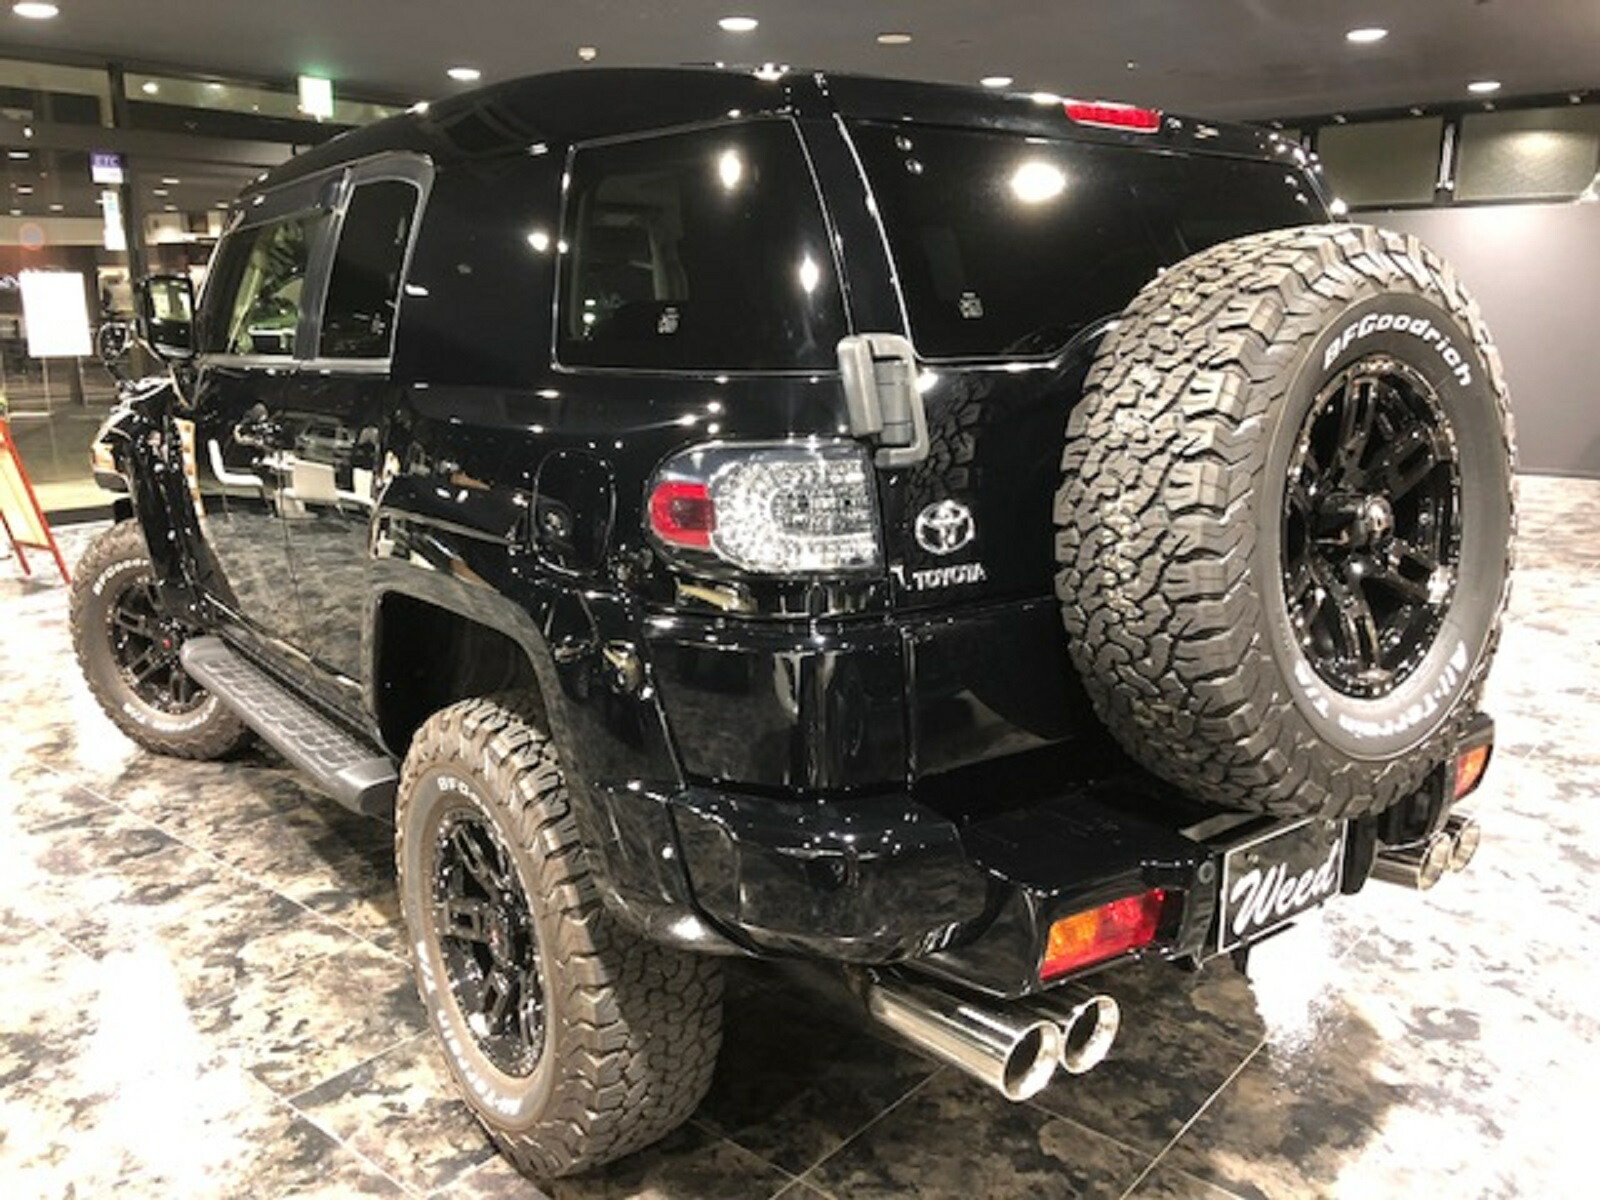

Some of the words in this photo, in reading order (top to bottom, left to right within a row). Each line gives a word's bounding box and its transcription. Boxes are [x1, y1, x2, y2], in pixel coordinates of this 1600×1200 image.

[1324, 313, 1472, 386] BFGoodrich
[912, 562, 987, 591] TOYOTA
[1230, 838, 1341, 935] Weed
